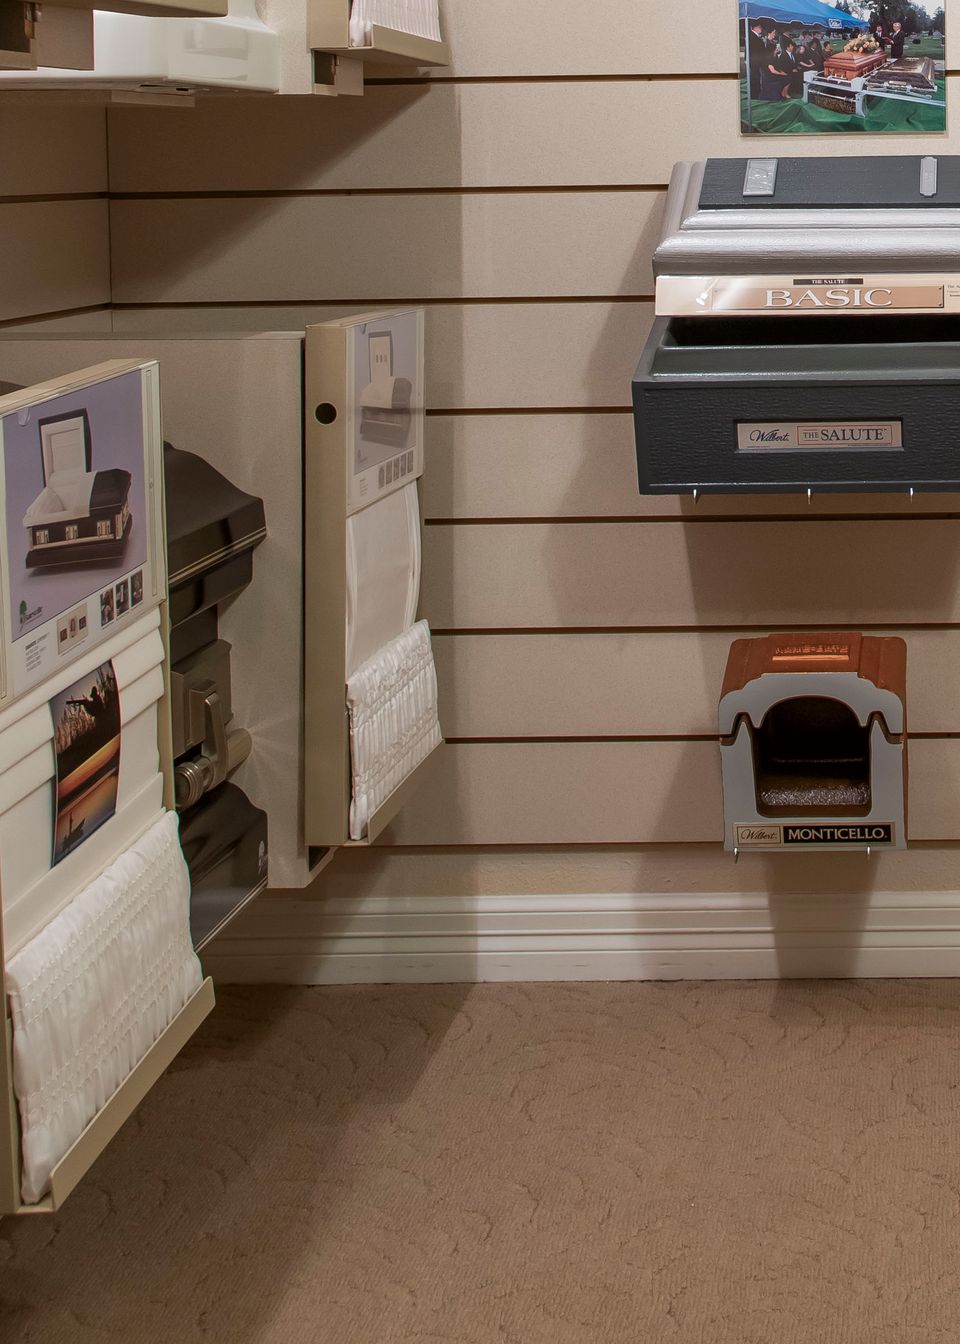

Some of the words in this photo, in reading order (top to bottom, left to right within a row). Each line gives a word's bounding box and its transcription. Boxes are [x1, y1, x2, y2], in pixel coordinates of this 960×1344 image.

[765, 288, 892, 307] BASIC
[803, 430, 819, 438] THE
[820, 428, 884, 441] SALUTE
[788, 827, 885, 840] MONTICELLO
